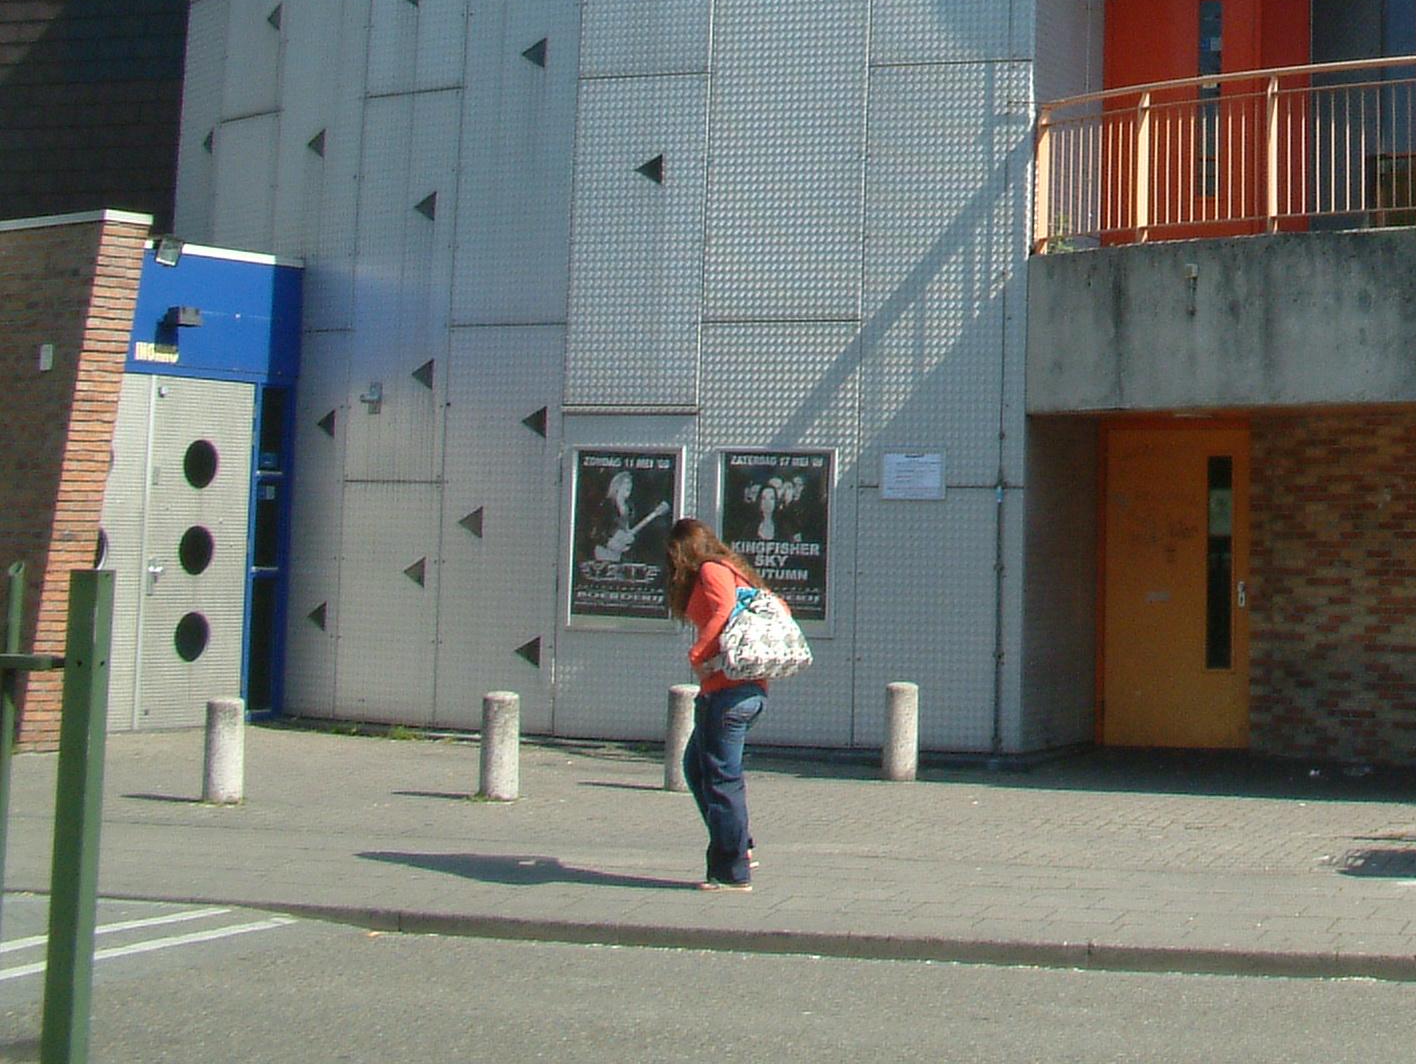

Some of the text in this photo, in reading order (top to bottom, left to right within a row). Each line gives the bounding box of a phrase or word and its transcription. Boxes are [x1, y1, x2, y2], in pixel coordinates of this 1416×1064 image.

[730, 455, 777, 466] ZATERDAG
[779, 456, 791, 467] 17
[731, 540, 820, 556] KINGFISHER
[754, 555, 789, 568] SKY
[756, 568, 809, 581] UTUMN
